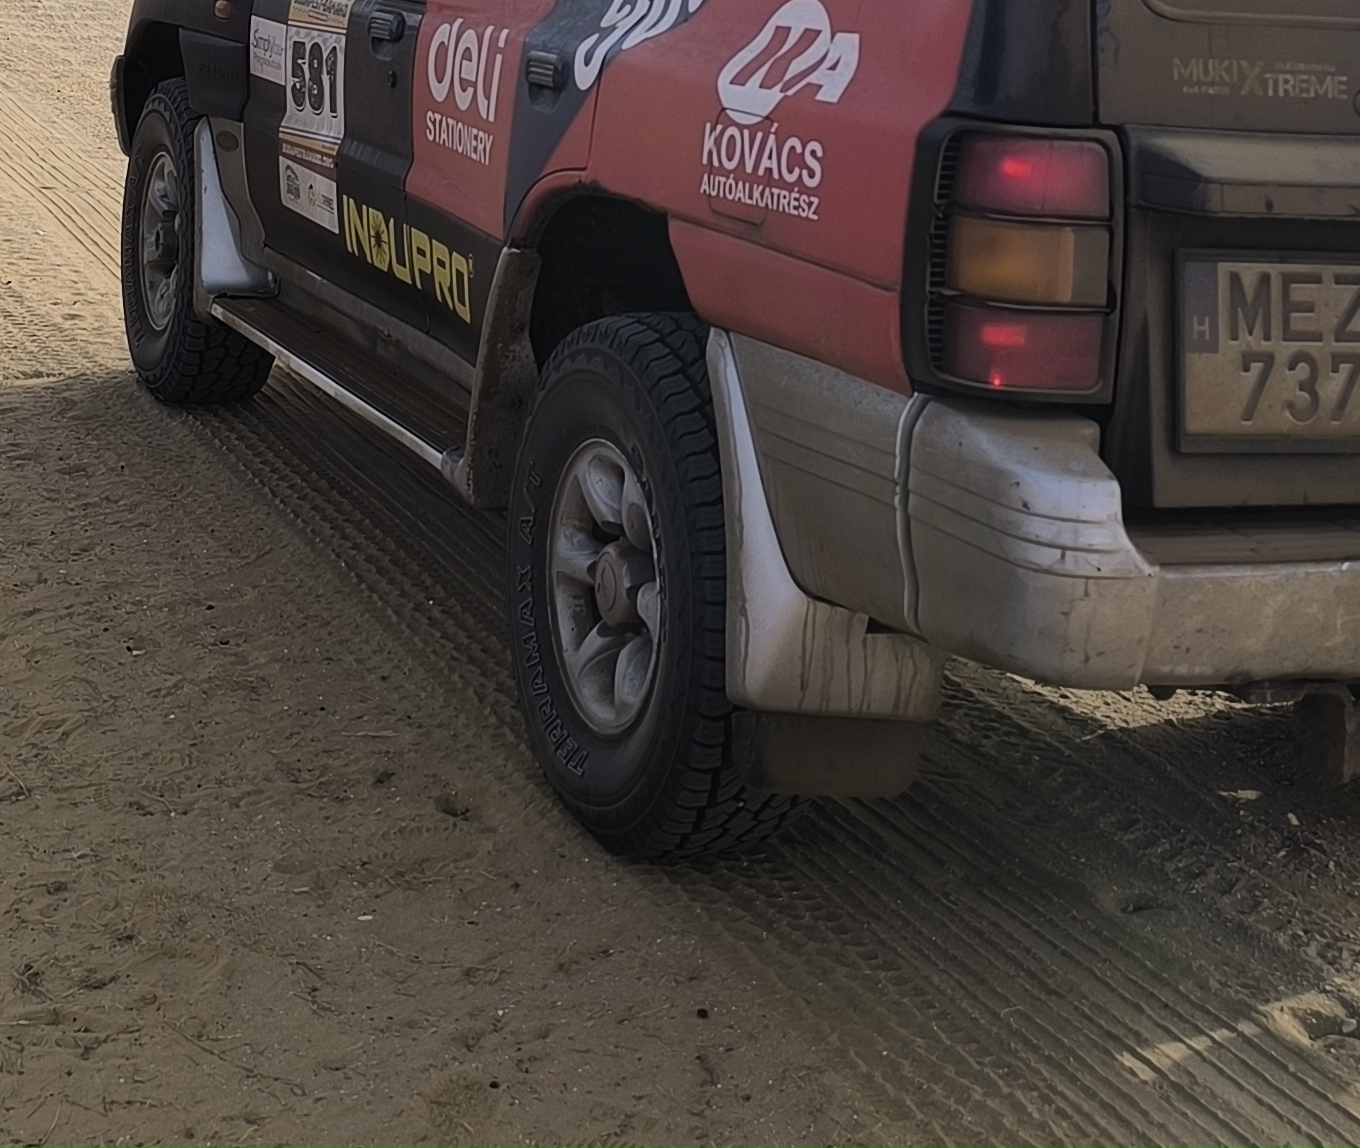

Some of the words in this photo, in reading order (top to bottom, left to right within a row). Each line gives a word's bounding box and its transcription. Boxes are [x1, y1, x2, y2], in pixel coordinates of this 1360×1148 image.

[291, 40, 338, 119] 581
[428, 17, 510, 122] deli
[425, 110, 494, 166] STATIONERY
[702, 122, 824, 188] KOVÁCS
[699, 173, 820, 221] AUTÓALKATRÉSZ
[1192, 315, 1210, 341] H
[516, 565, 590, 778] TERRAMAX
